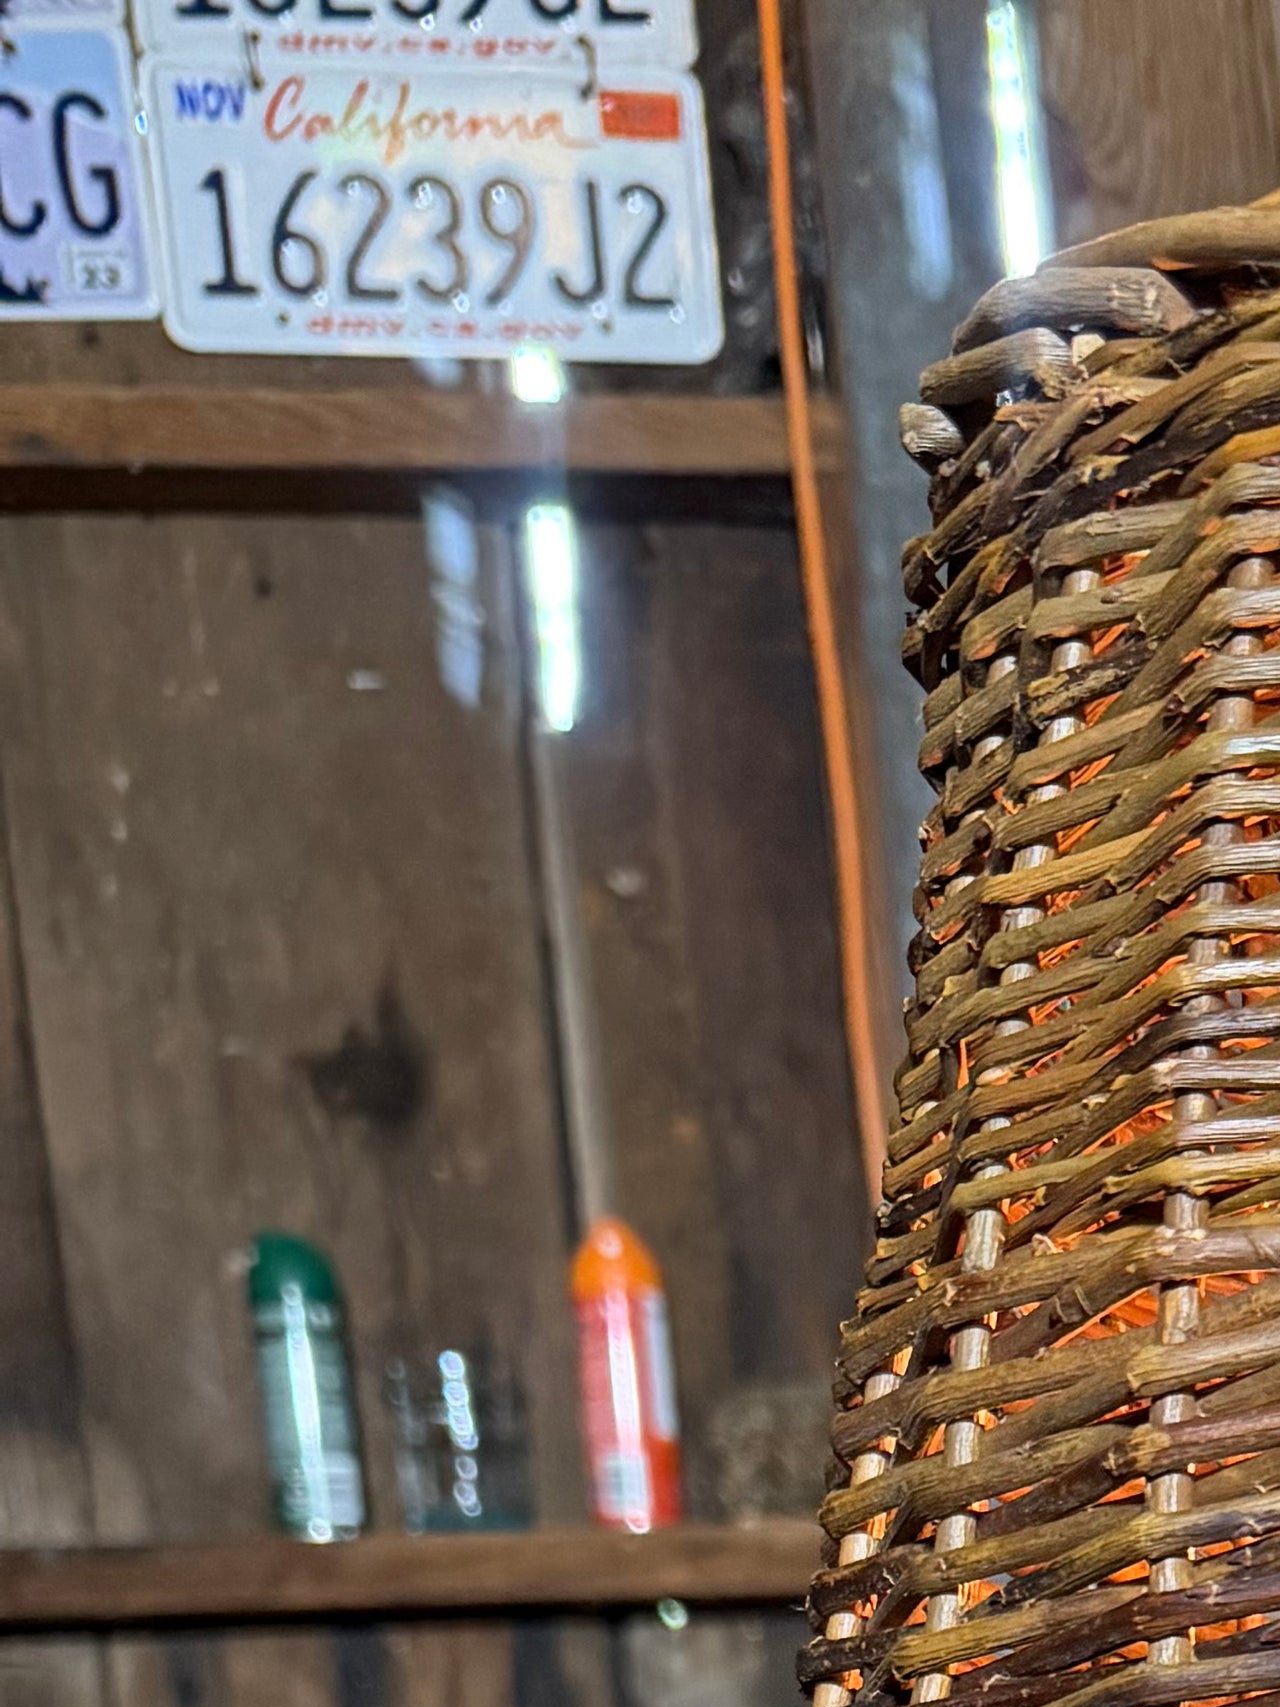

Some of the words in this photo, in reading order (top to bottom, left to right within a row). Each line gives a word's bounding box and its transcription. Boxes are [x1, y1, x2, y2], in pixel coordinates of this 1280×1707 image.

[175, 83, 244, 121] NOV
[264, 75, 599, 165] California
[200, 168, 675, 307] 16239J2
